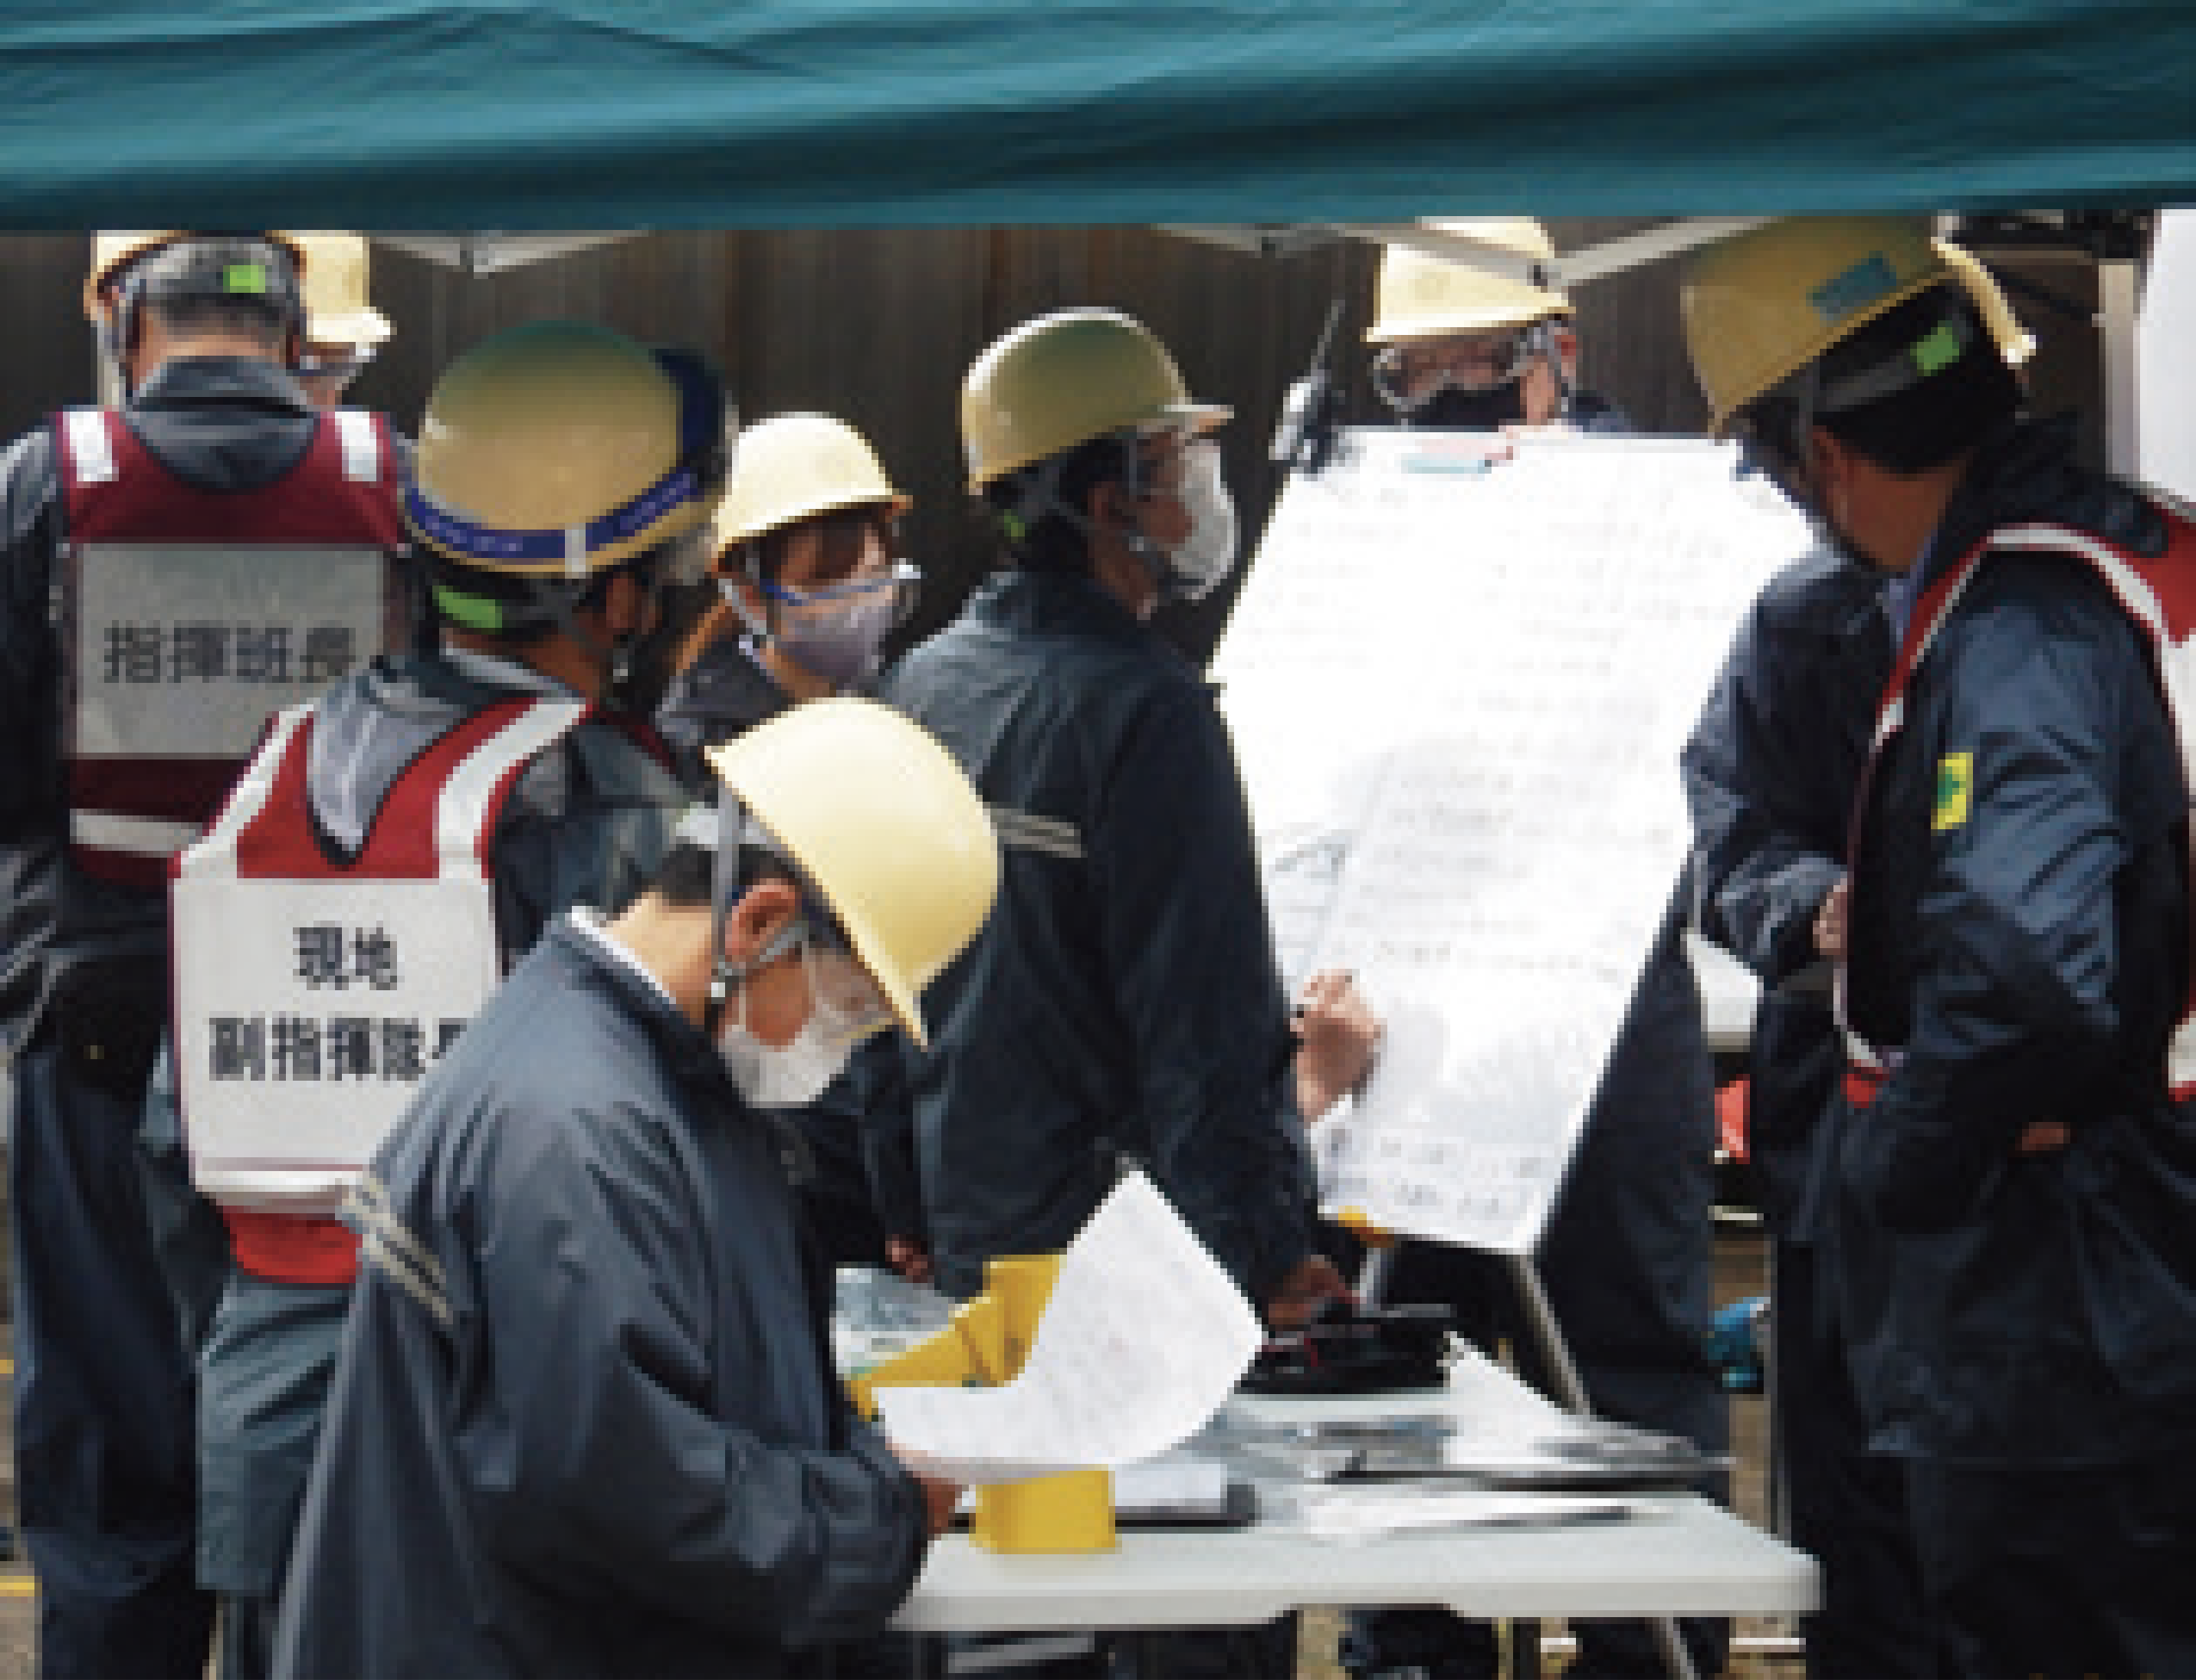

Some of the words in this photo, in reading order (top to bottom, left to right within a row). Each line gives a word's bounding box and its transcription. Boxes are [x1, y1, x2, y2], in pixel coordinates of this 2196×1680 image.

[103, 619, 356, 684] 指揮班長
[293, 922, 398, 990] 現地
